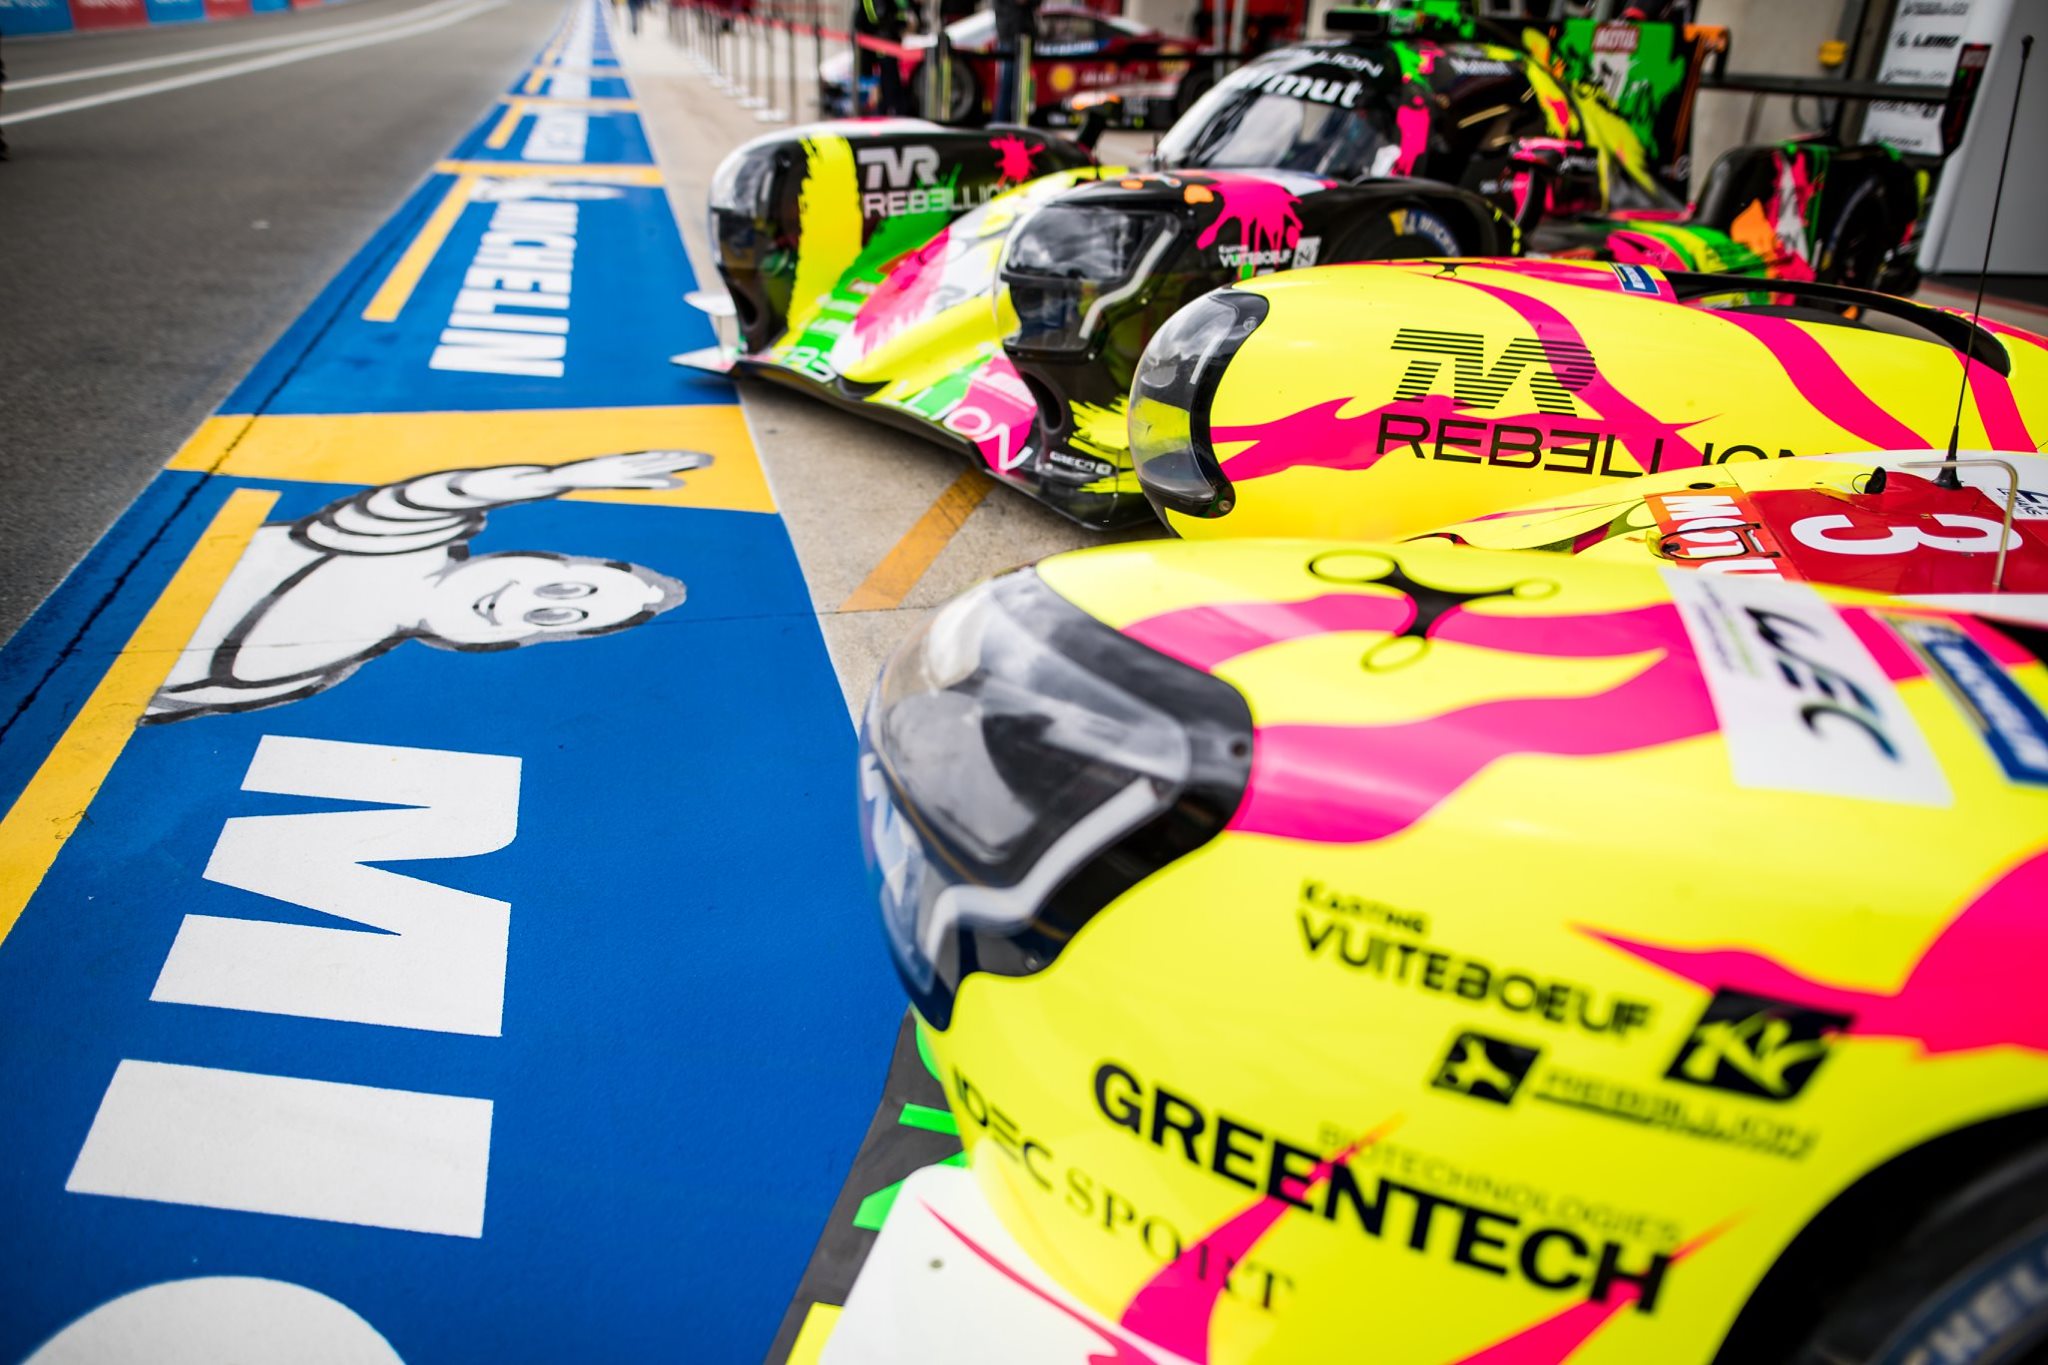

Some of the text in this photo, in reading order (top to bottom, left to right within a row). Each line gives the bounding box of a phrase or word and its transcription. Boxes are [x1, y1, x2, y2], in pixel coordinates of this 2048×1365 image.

[857, 144, 940, 190] TVR
[863, 183, 1011, 219] REBELLIO
[428, 201, 579, 378] MICHELIN
[1391, 327, 1597, 418] TVR
[1376, 413, 1836, 478] REBELLIO
[1660, 495, 1785, 582] MOTU
[1790, 514, 2023, 556] 3
[1299, 912, 1652, 1036] VUITEBOEUF
[1093, 1062, 1671, 1316] GREENTECH
